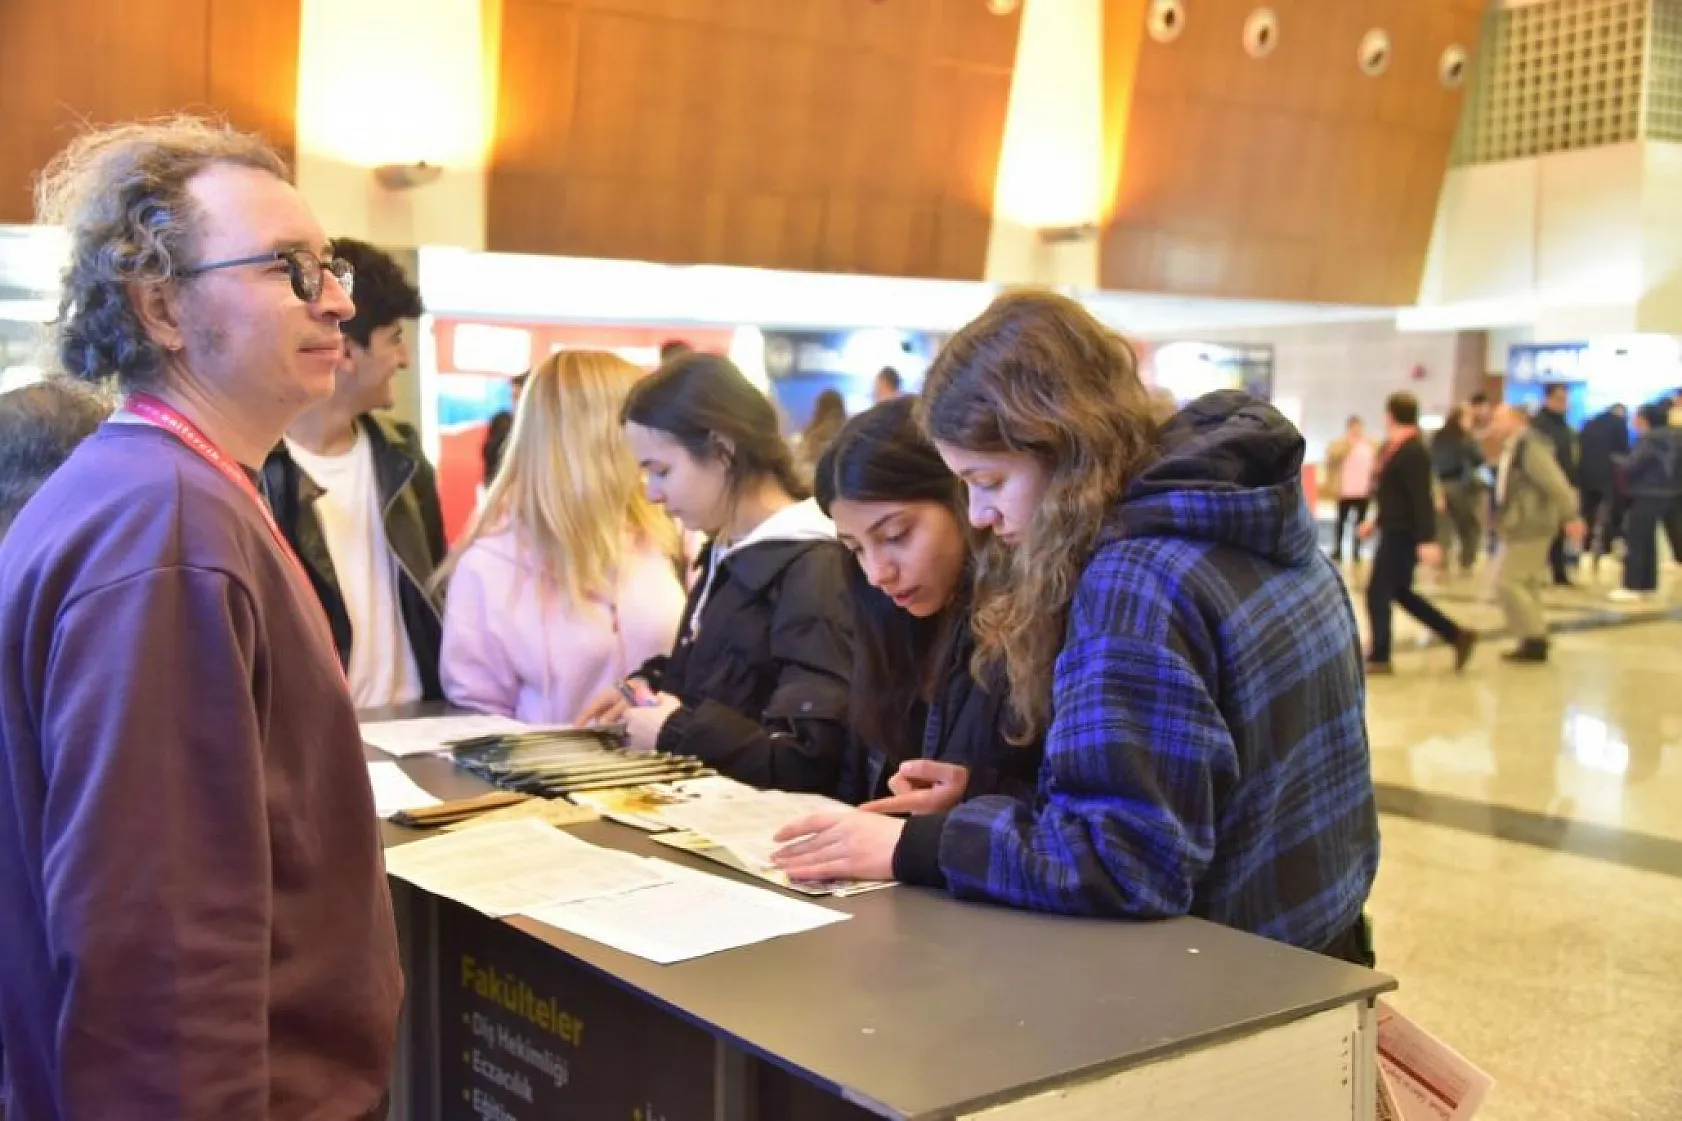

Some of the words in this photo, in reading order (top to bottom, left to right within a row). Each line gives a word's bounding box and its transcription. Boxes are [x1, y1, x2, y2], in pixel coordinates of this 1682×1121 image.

[462, 955, 583, 1045] Fakülteler
[473, 1012, 495, 1049] Diş
[499, 1024, 569, 1088] Hekimliği
[473, 1049, 533, 1103] Eczacılık
